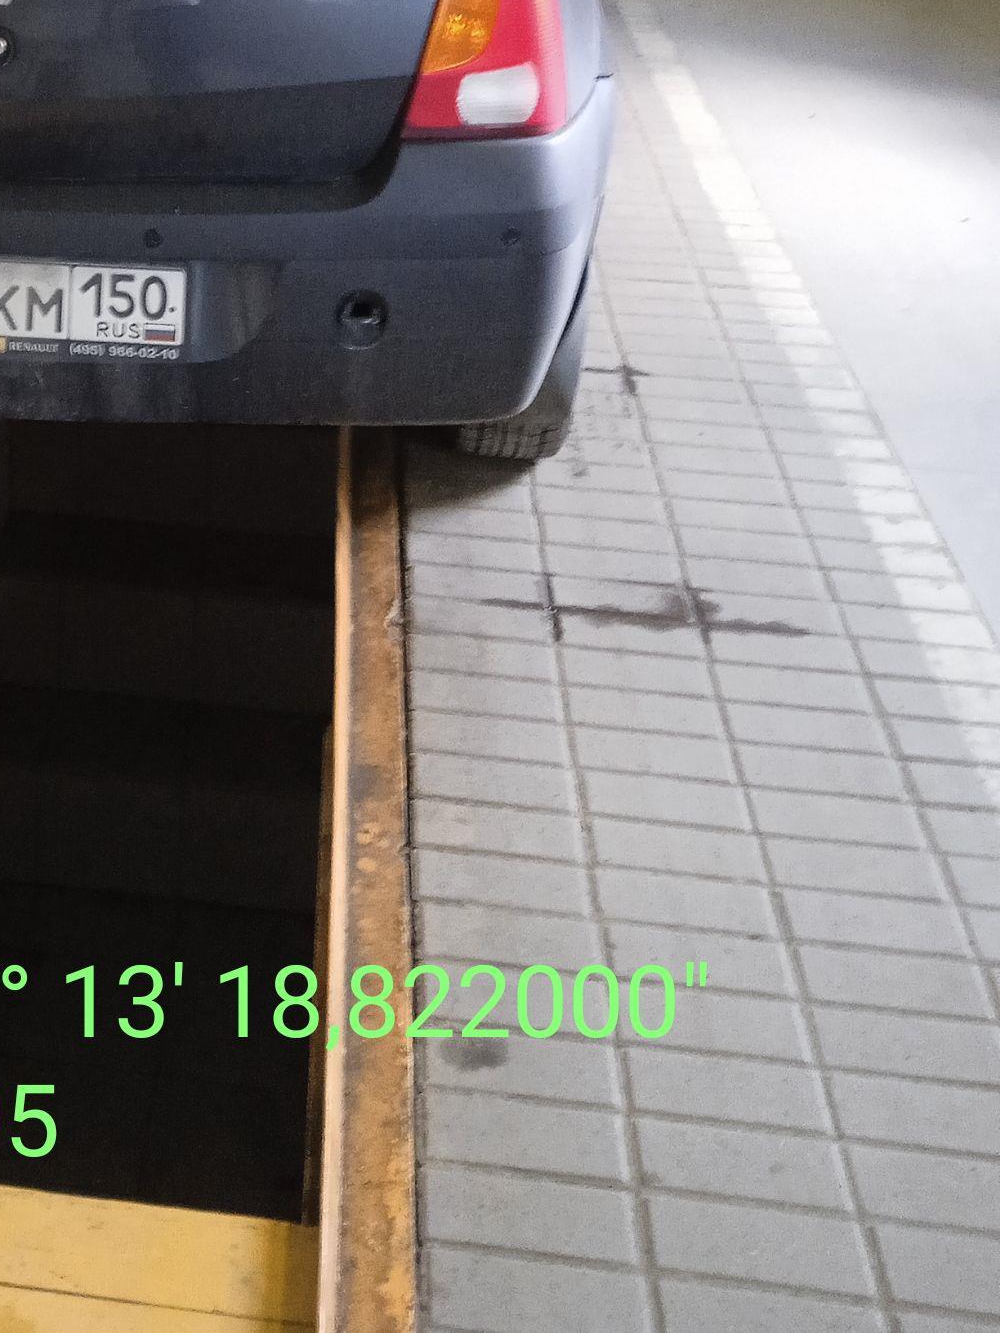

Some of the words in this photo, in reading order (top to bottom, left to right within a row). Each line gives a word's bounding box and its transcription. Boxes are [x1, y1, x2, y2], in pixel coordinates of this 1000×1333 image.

[79, 273, 168, 321] 150
[96, 322, 142, 339] RUS
[8, 341, 60, 354] RENAULT
